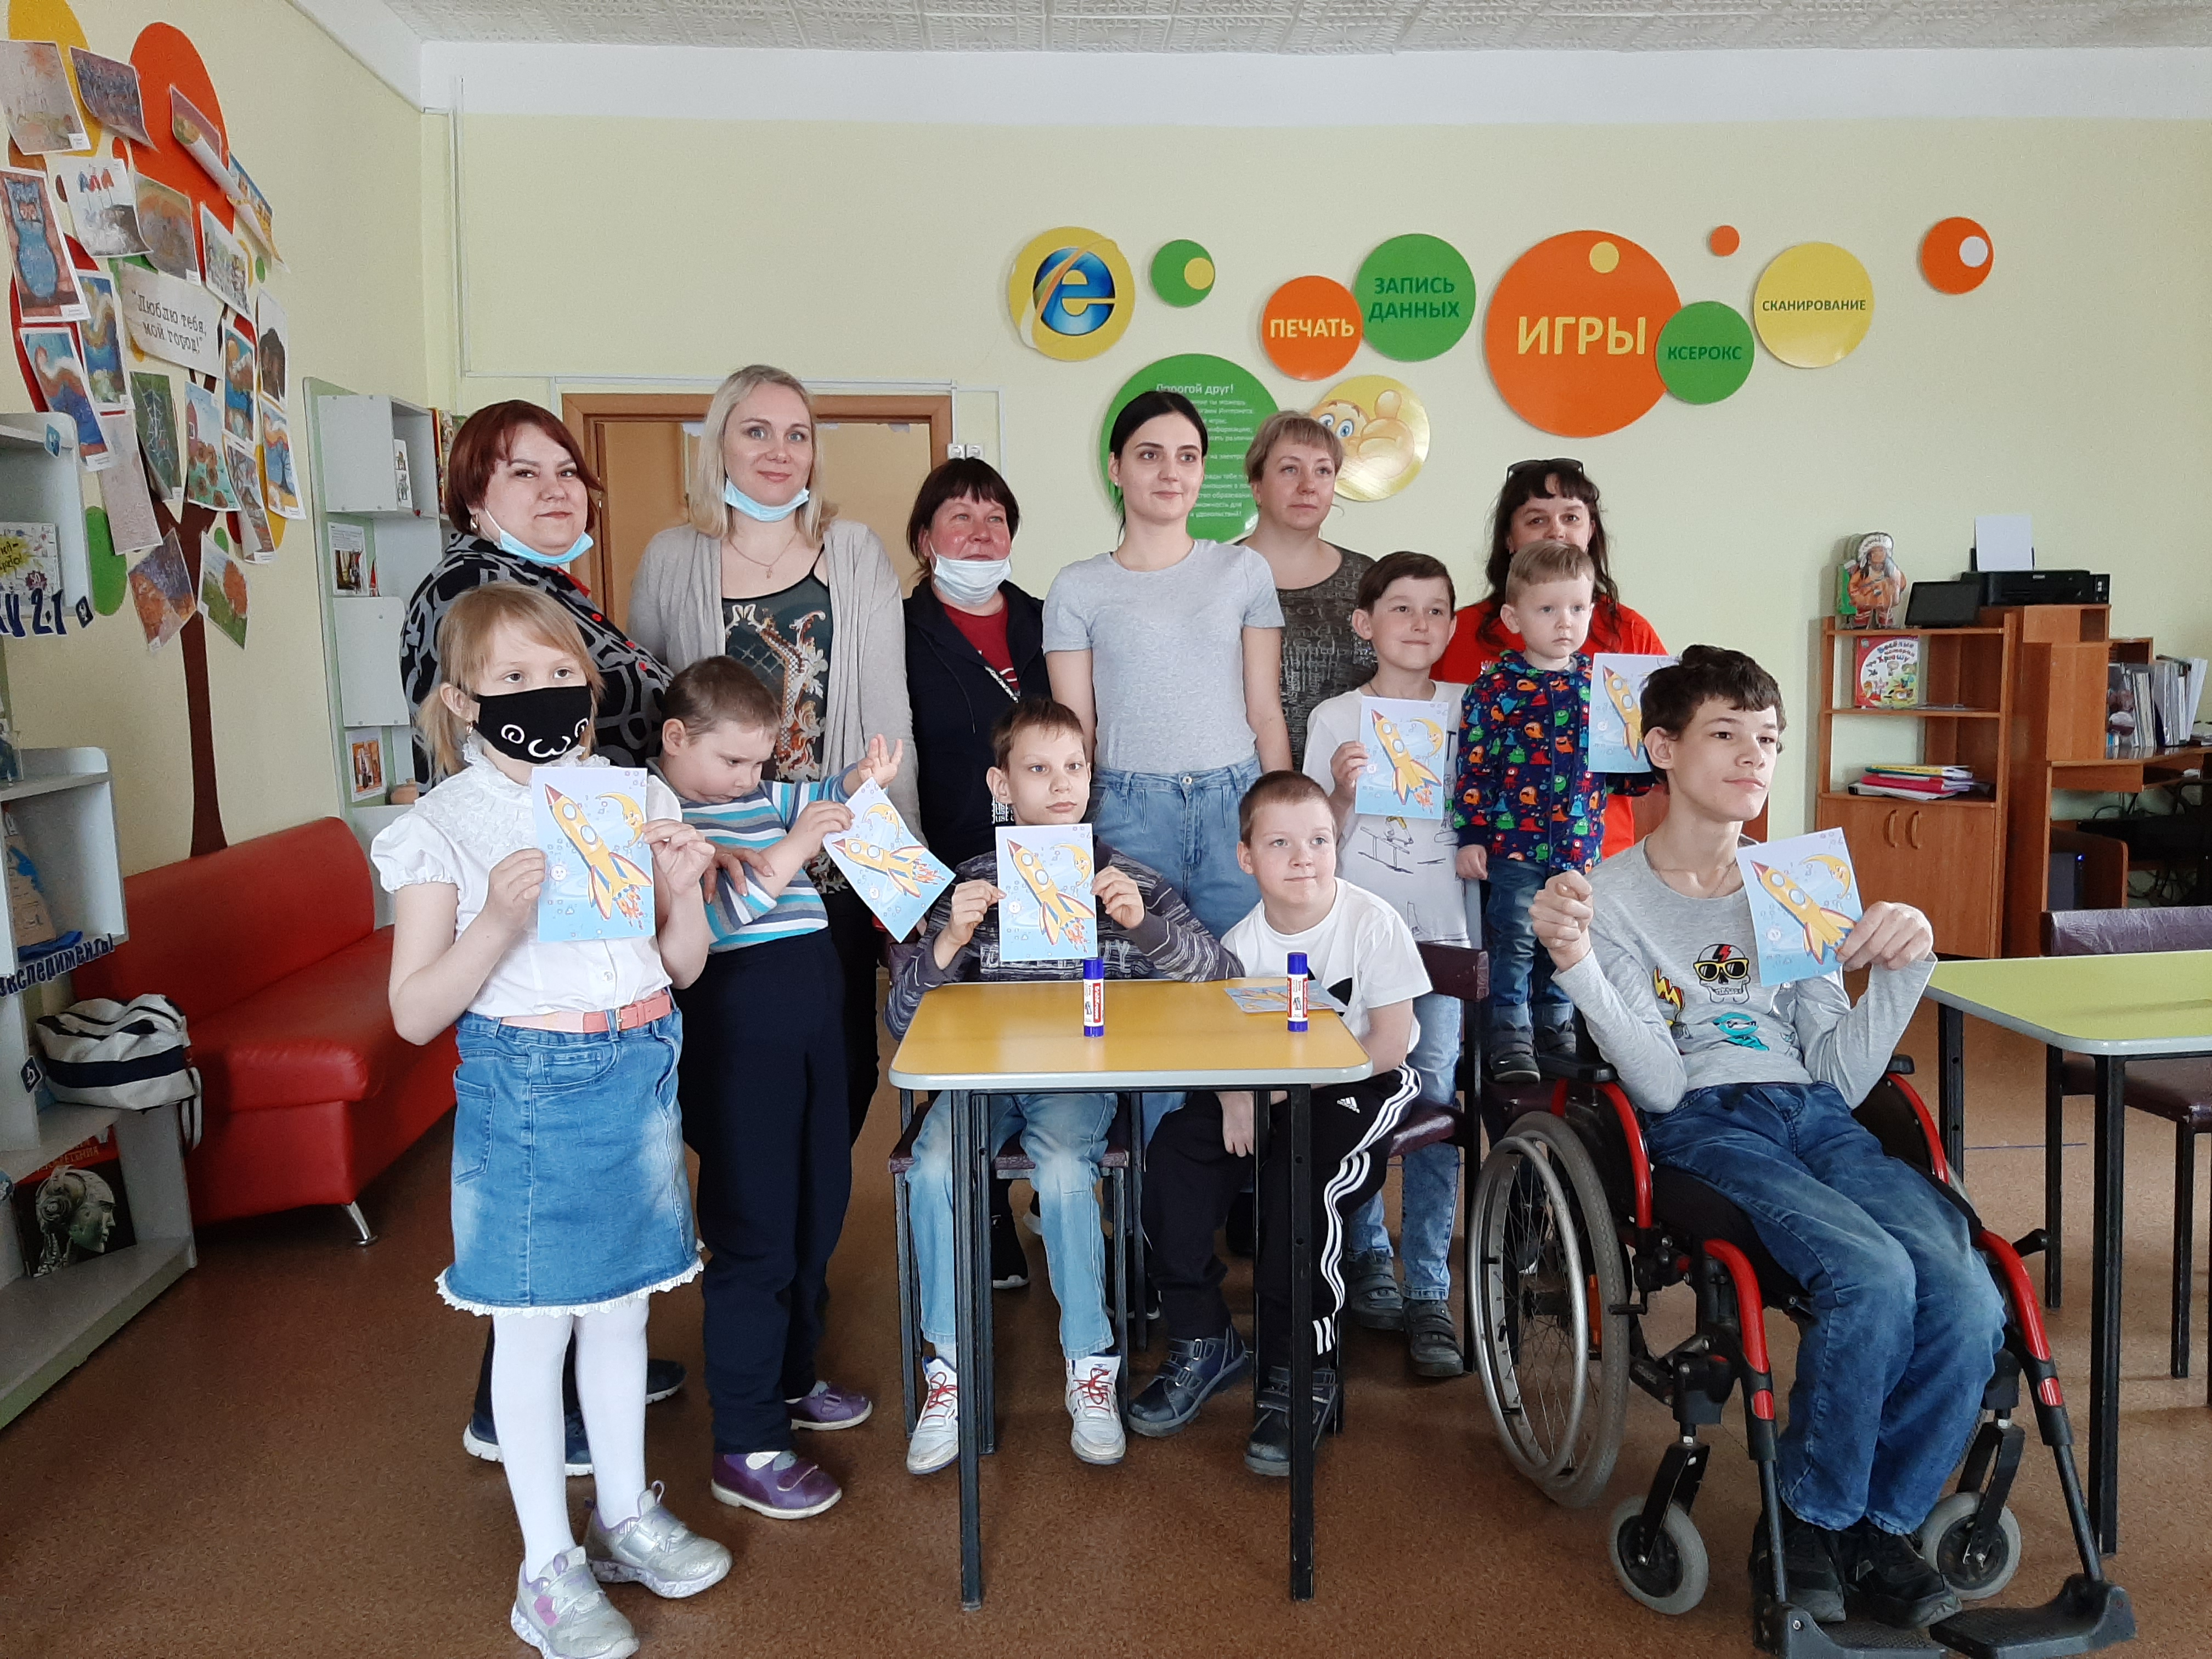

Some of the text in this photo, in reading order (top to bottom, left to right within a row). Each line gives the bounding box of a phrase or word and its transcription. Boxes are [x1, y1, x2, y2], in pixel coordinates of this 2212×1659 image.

[1374, 276, 1455, 294] ЗАПИСЬ
[1368, 301, 1460, 323] ДАННЫХ
[1762, 299, 1866, 311] СКАНИРОВАНИЕ
[1269, 318, 1355, 338] ПЕЧАТЬ
[1517, 316, 1646, 355] ИГРЫ
[1667, 346, 1742, 360] КСЕРОКС
[1204, 384, 1234, 396] друг!
